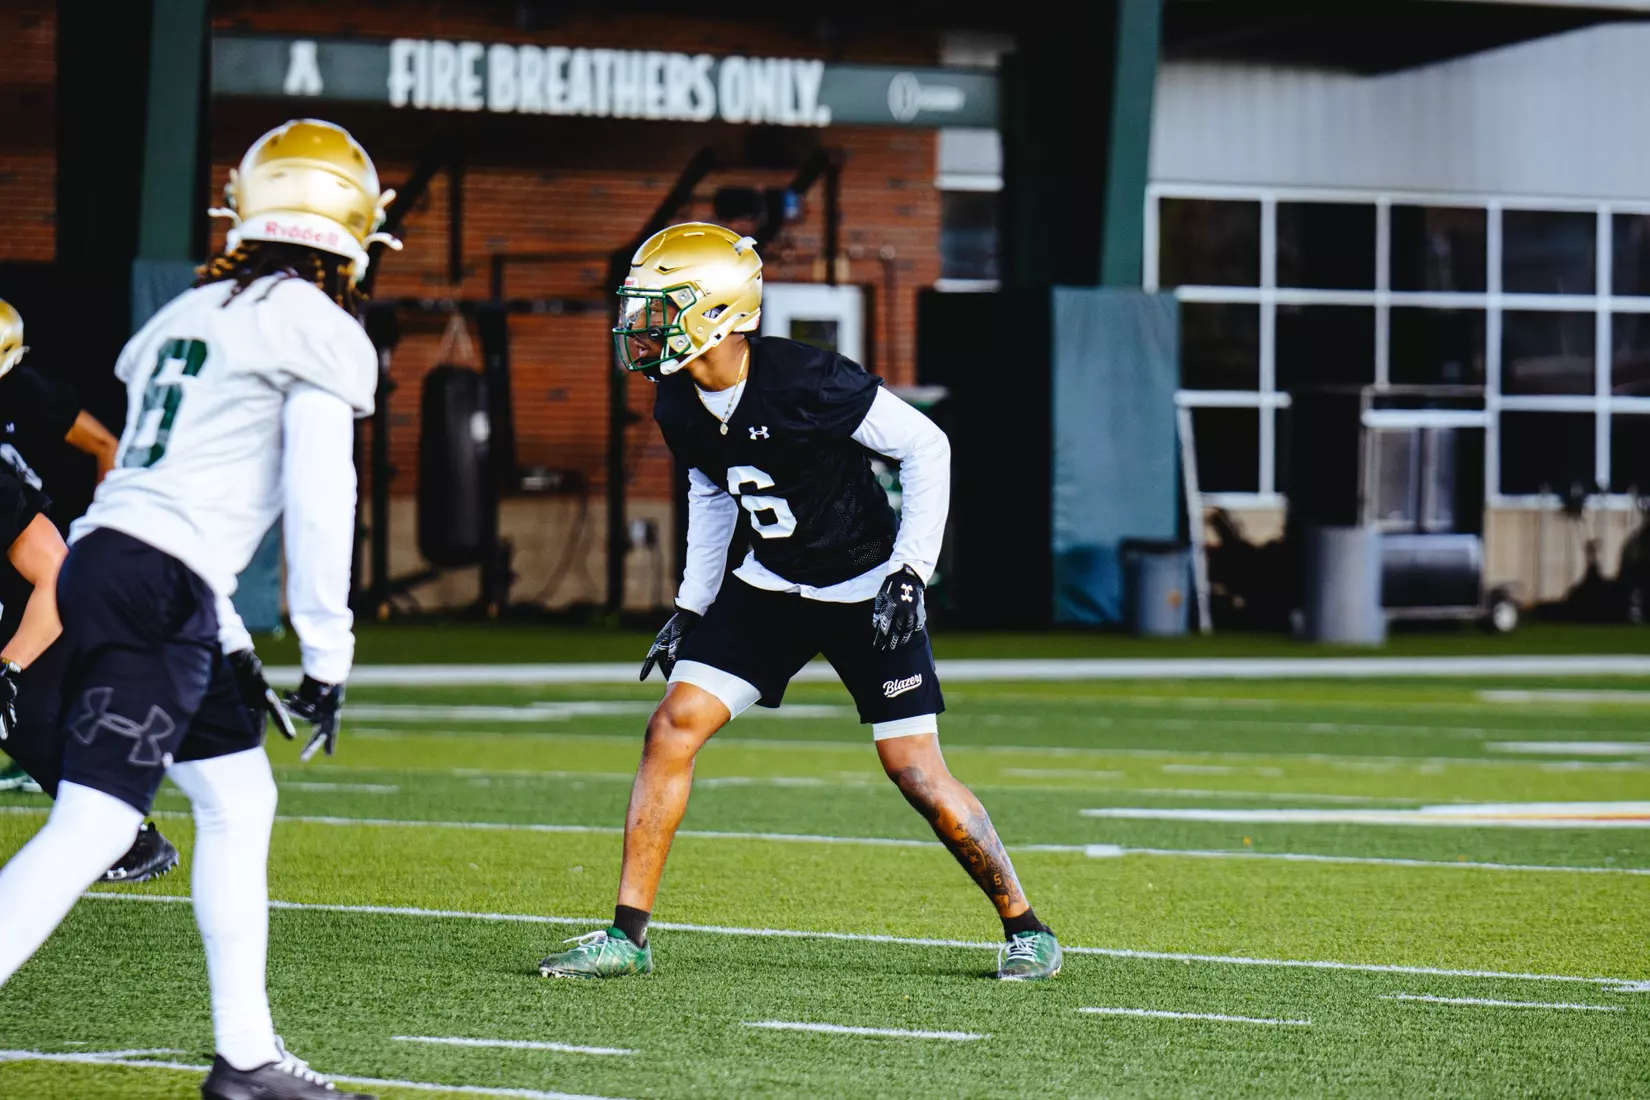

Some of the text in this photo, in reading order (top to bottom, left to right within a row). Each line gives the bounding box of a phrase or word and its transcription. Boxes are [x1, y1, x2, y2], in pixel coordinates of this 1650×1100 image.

[388, 39, 832, 127] FIRE BREATHERS ONLY.
[122, 338, 208, 468] 6
[727, 465, 797, 539] 6
